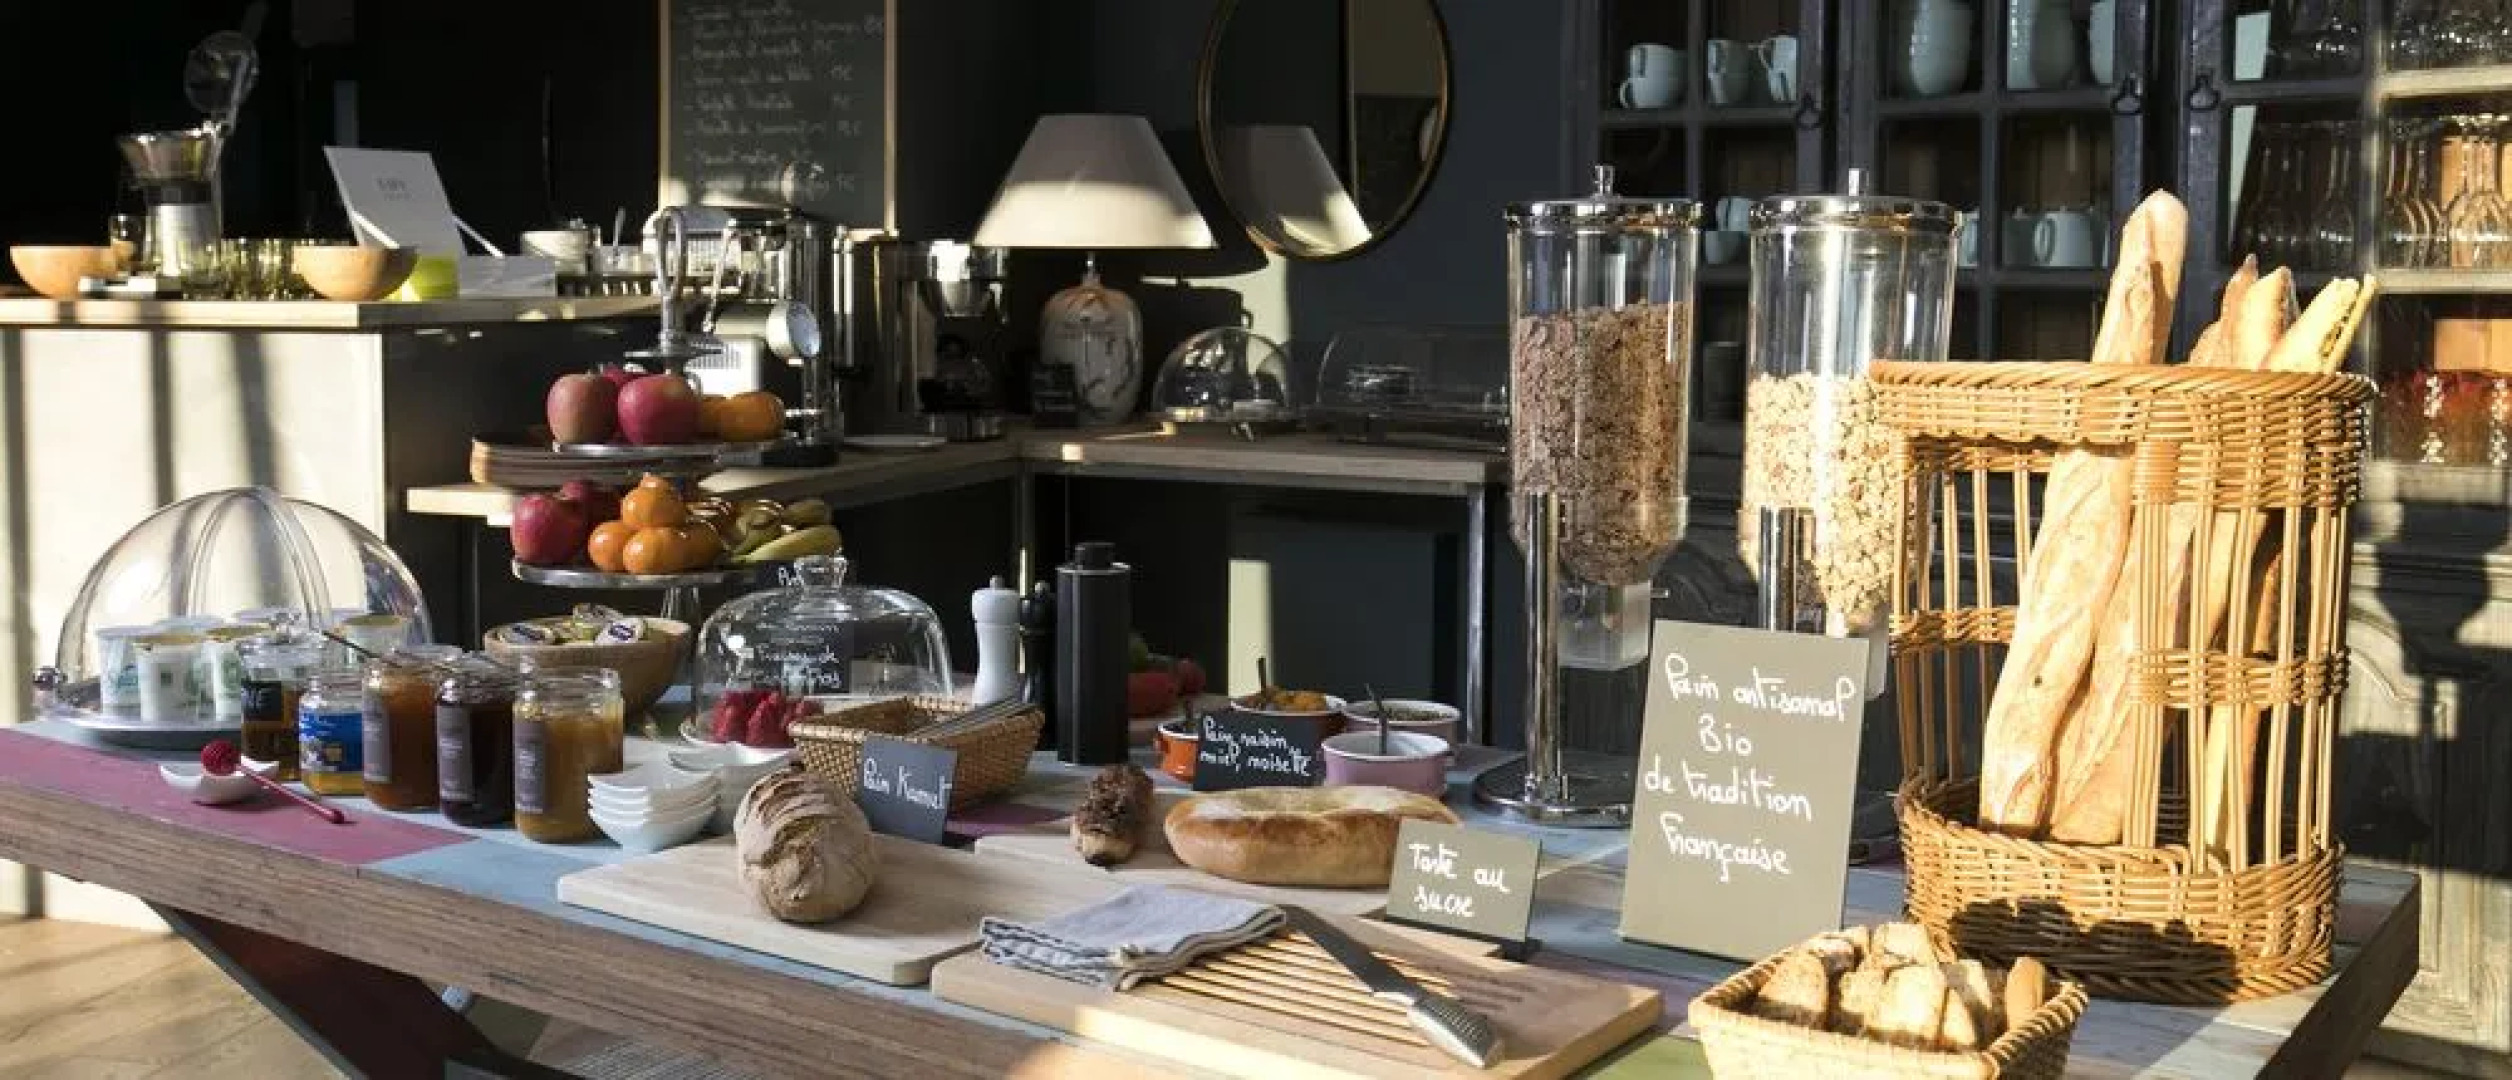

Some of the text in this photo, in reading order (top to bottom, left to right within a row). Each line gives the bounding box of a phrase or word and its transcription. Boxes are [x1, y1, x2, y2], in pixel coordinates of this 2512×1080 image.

[1664, 652, 1856, 722] Pain artisanal
[1202, 715, 1233, 742] Pain
[1698, 713, 1752, 756] Bio
[863, 757, 953, 810] Pain Kamut
[1247, 746, 1312, 777] noisette
[1644, 753, 1812, 823] de tradition
[1408, 843, 1512, 894] Tarte au
[1660, 811, 1792, 884] Française
[1413, 884, 1475, 918] sucre
